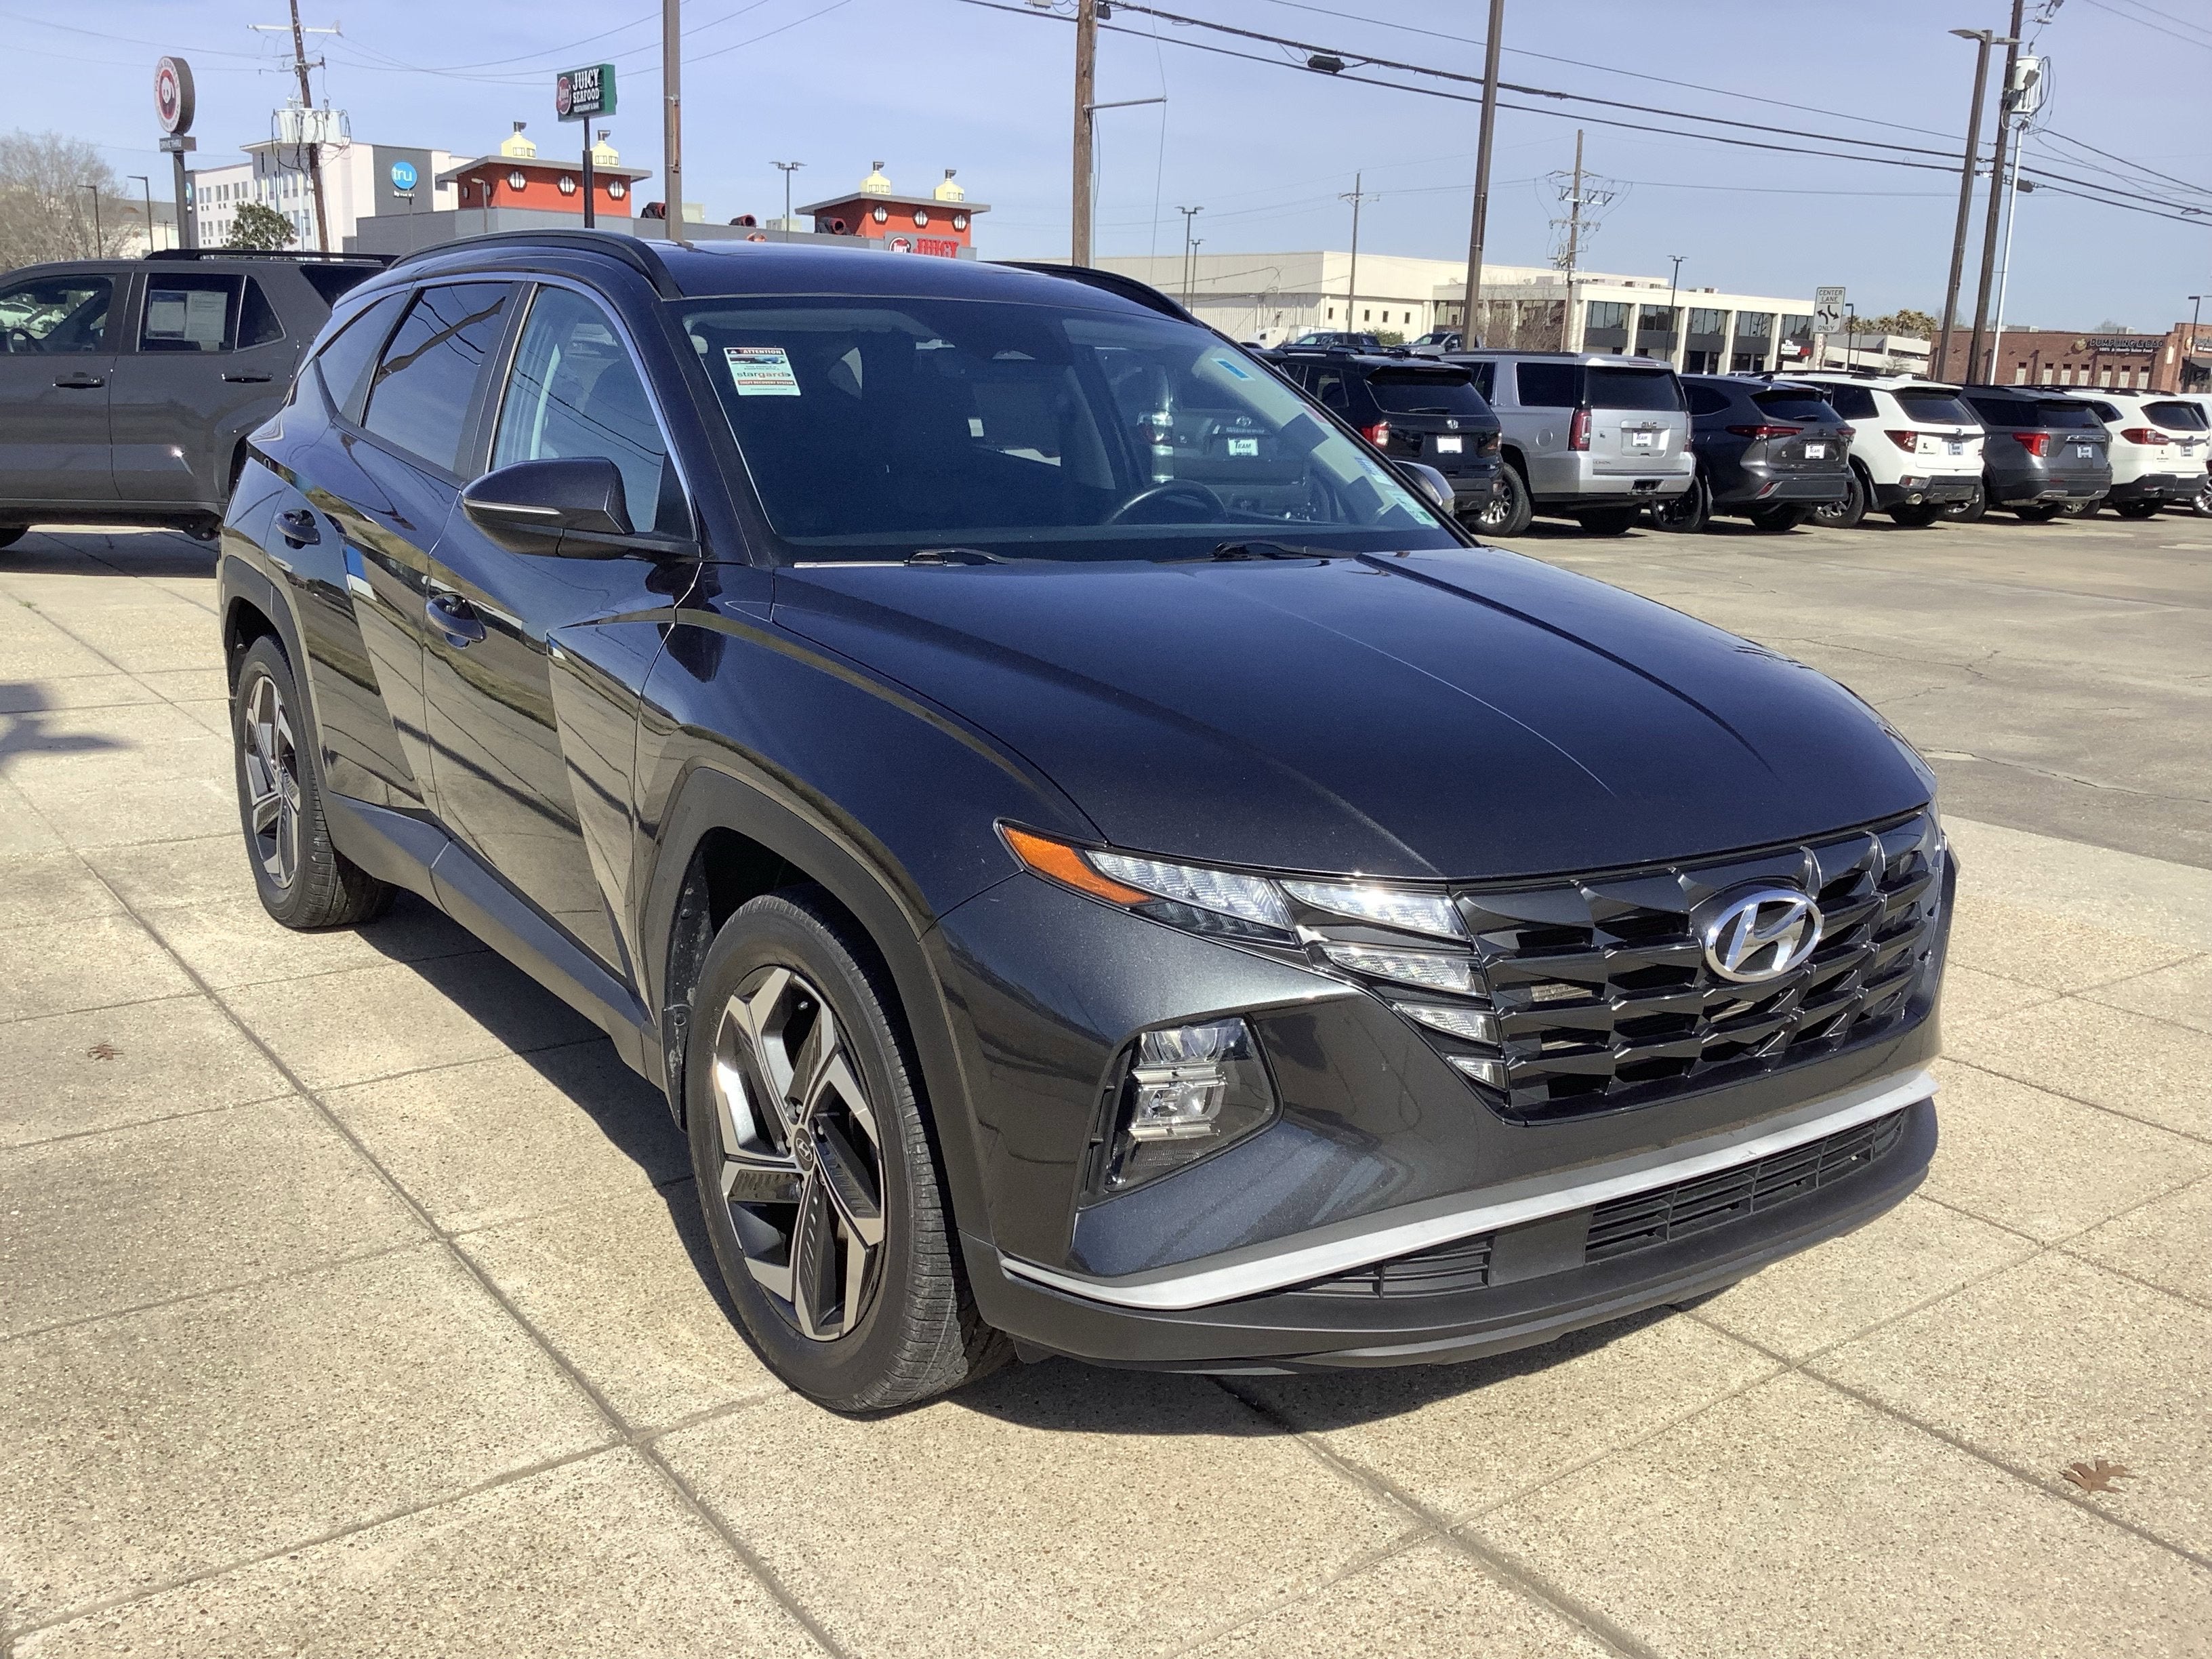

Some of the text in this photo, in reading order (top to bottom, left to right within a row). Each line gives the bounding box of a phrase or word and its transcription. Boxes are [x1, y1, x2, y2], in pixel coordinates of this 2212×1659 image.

[573, 68, 599, 91] JUICY
[573, 87, 600, 104] SEAFOOD
[391, 166, 413, 182] tru
[2145, 340, 2165, 348] BAO
[1234, 441, 1252, 449] TEAM
